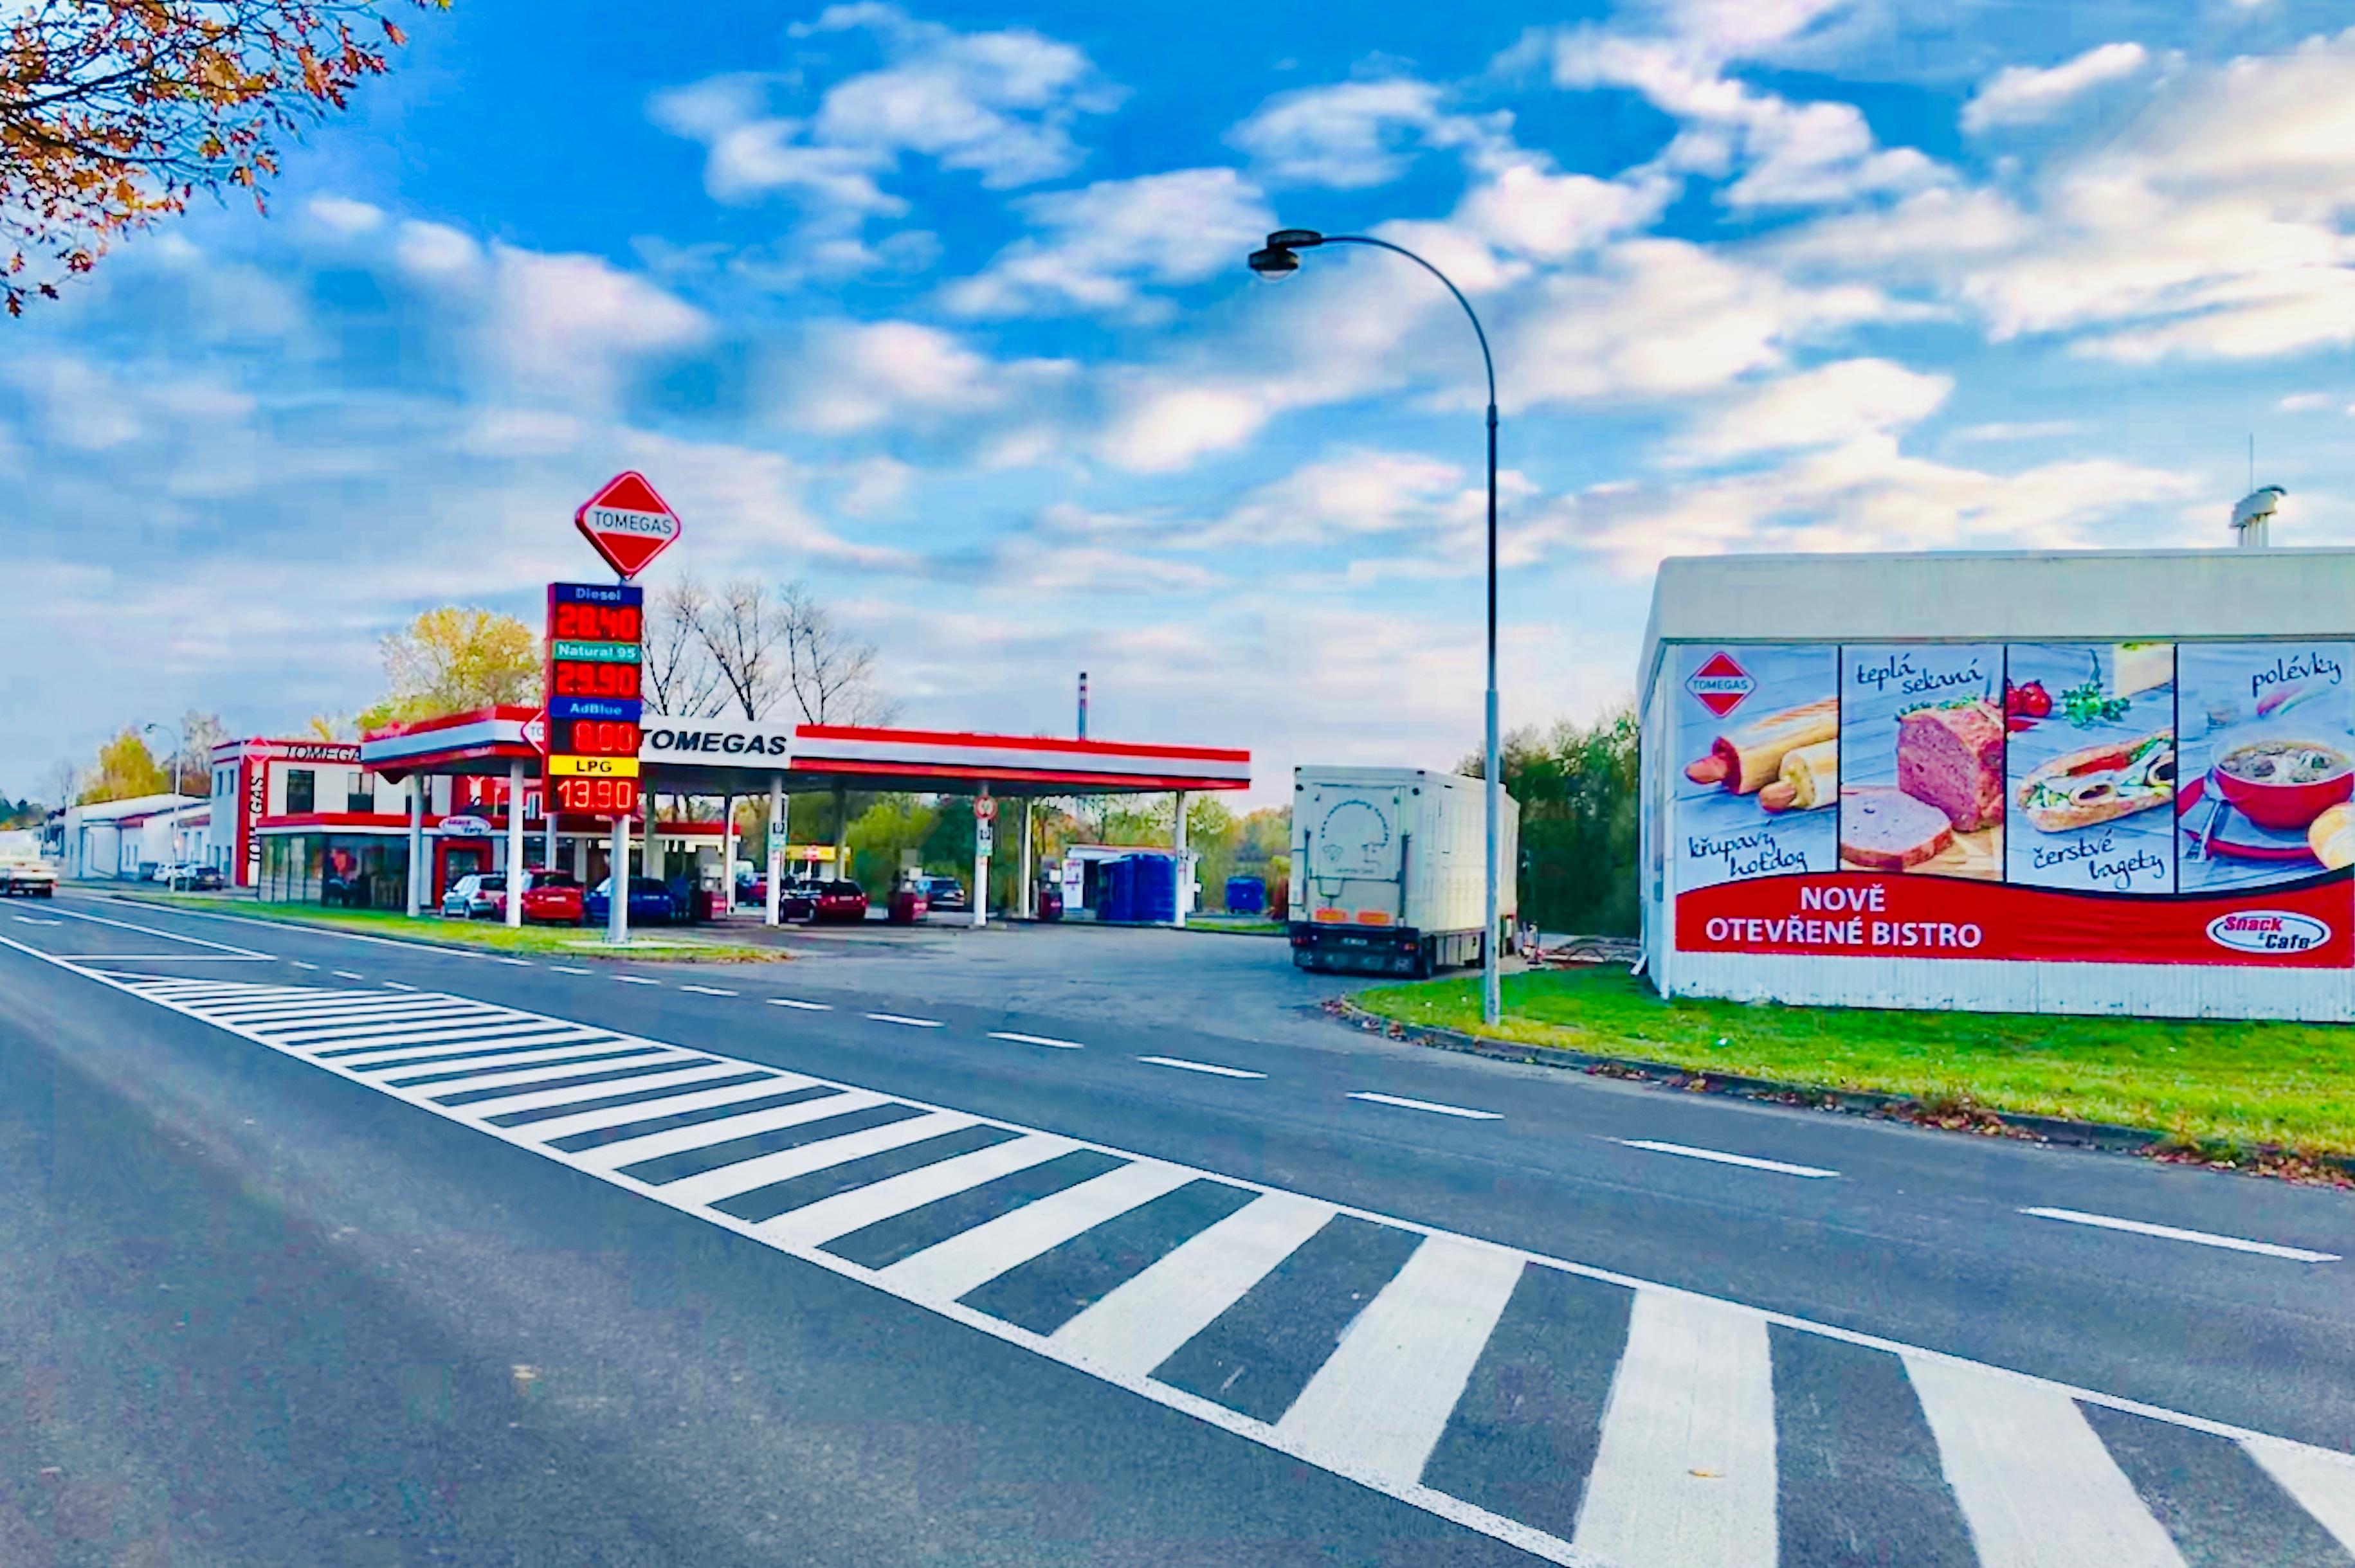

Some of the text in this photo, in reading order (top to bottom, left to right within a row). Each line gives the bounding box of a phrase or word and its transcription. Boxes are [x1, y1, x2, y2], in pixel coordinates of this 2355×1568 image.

[593, 510, 673, 535] TOMEGAS
[575, 587, 622, 600] Diesel
[556, 603, 637, 639] 28.40
[558, 644, 637, 659] Natural 95
[556, 662, 636, 696] 29.90
[1693, 680, 1748, 690] TOMEGAS
[1857, 653, 1916, 692] teplá
[1902, 658, 1984, 695] sekaná
[2252, 651, 2342, 698] polévky
[570, 703, 623, 716] AdBlue
[284, 744, 361, 763] TOMEGA
[576, 761, 612, 772] LPG
[557, 780, 632, 809] 13.90
[1729, 847, 1809, 877] hotdog
[2033, 828, 2116, 869] čerstvé
[2089, 849, 2165, 890] bagety
[1800, 883, 1886, 912] NOVĚ
[1705, 914, 1983, 948] OTEVŘENÉ BISTRO
[2223, 916, 2283, 932] Snack
[2265, 933, 2311, 949] Cafe
